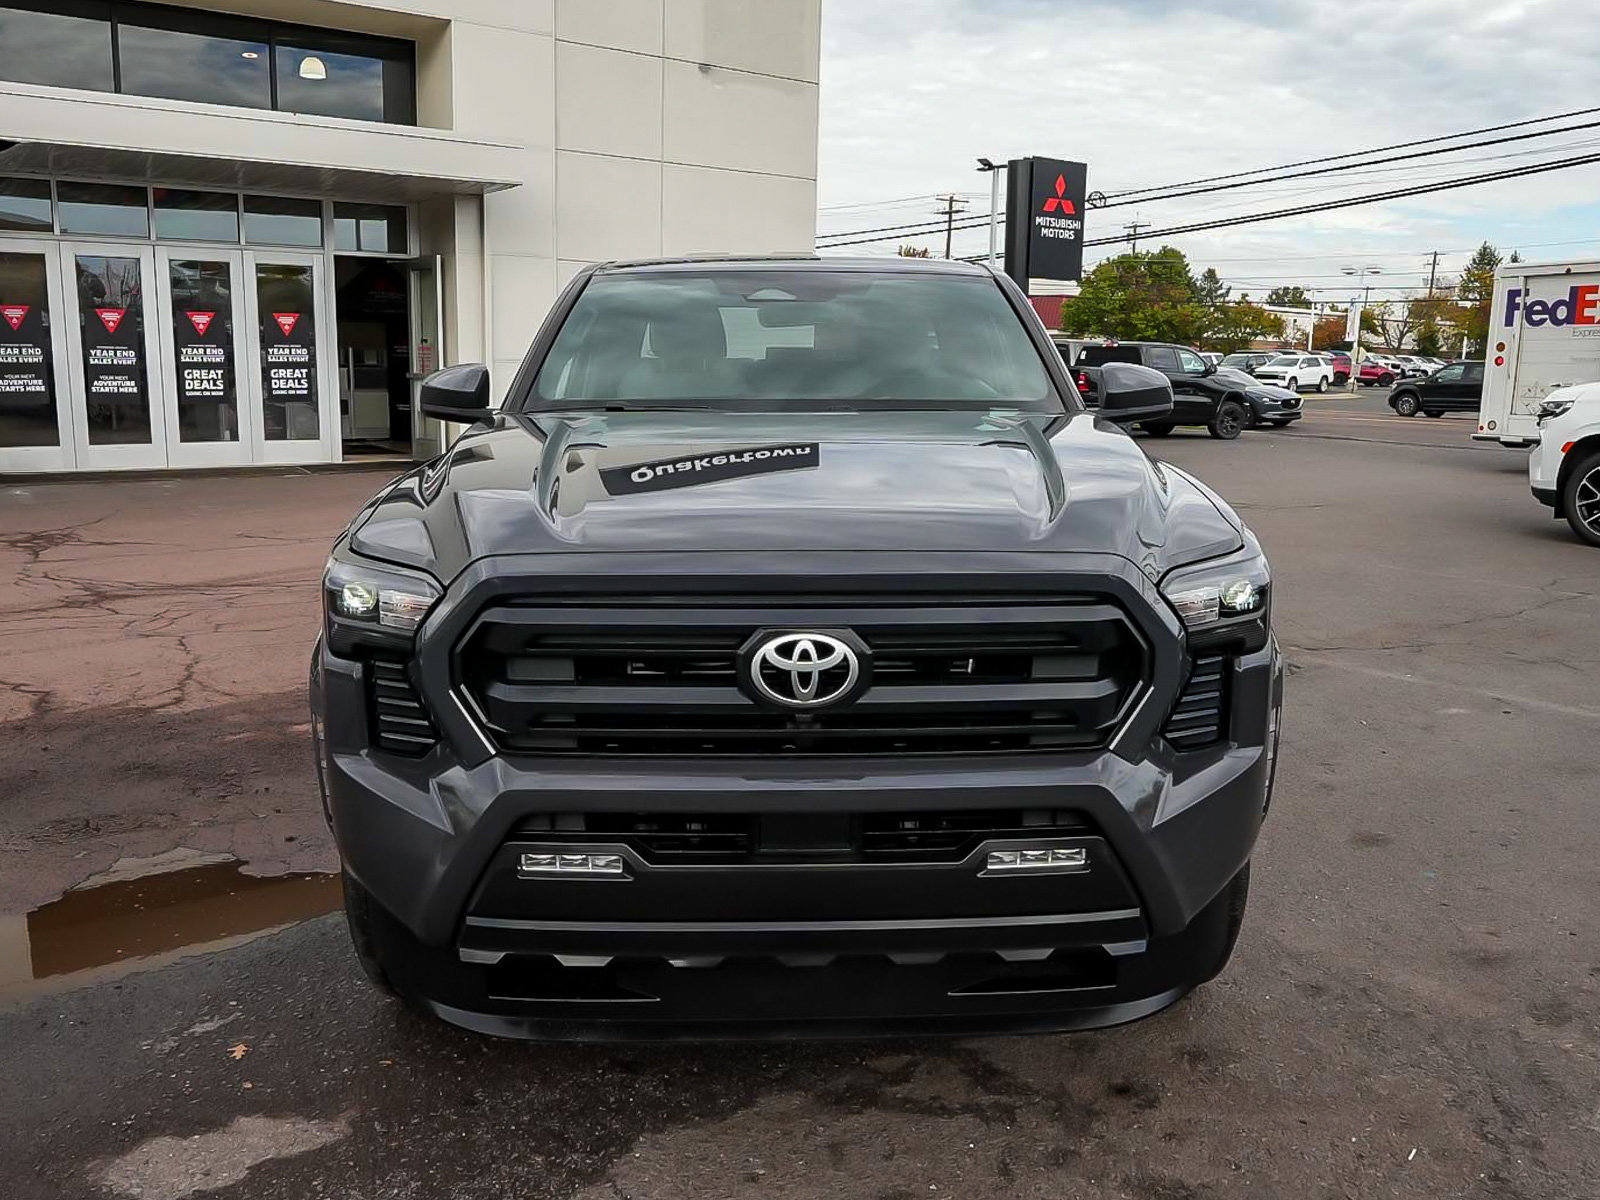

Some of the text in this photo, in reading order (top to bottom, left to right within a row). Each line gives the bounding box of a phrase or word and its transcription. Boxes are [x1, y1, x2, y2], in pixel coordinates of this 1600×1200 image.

[1035, 216, 1081, 230] MITSUBISHI
[1041, 228, 1075, 240] MOTORS
[1504, 285, 1600, 328] FedE
[0, 347, 42, 355] EAR END
[90, 349, 136, 358] YEAR END
[181, 347, 224, 355] YEAR END
[267, 347, 308, 355] YEAR END
[184, 368, 224, 380] GREAT
[270, 368, 308, 379] GREAT
[185, 379, 224, 390] DEALS
[271, 379, 308, 389] DEALS
